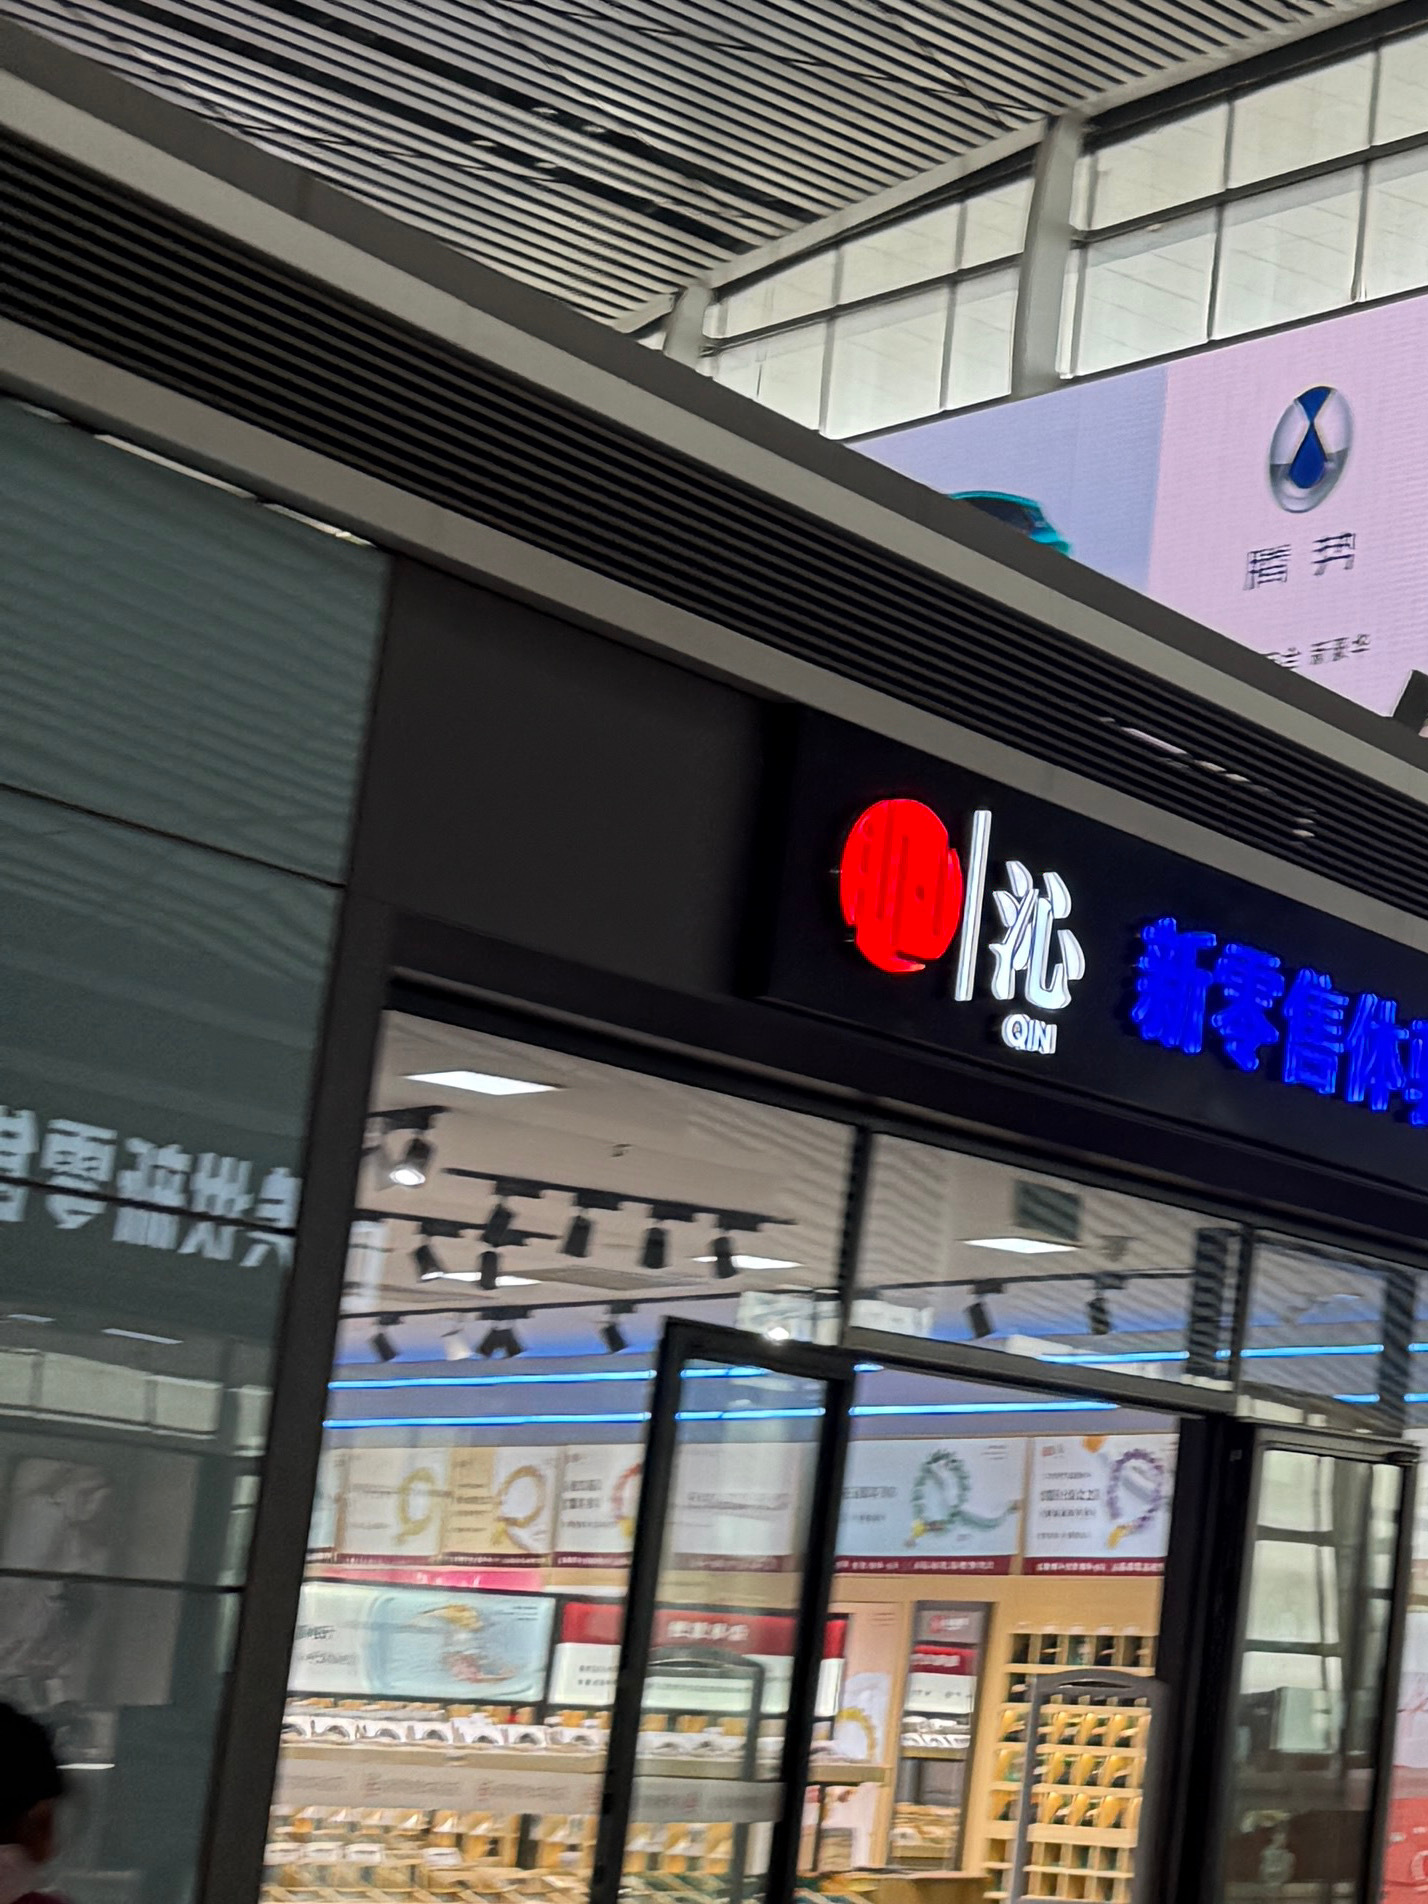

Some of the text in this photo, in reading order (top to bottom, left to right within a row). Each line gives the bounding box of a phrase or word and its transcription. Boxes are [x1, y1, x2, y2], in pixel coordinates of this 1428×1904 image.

[1243, 533, 1357, 591] 腾势
[989, 860, 1086, 1010] 沁
[1001, 1013, 1058, 1055] QIN
